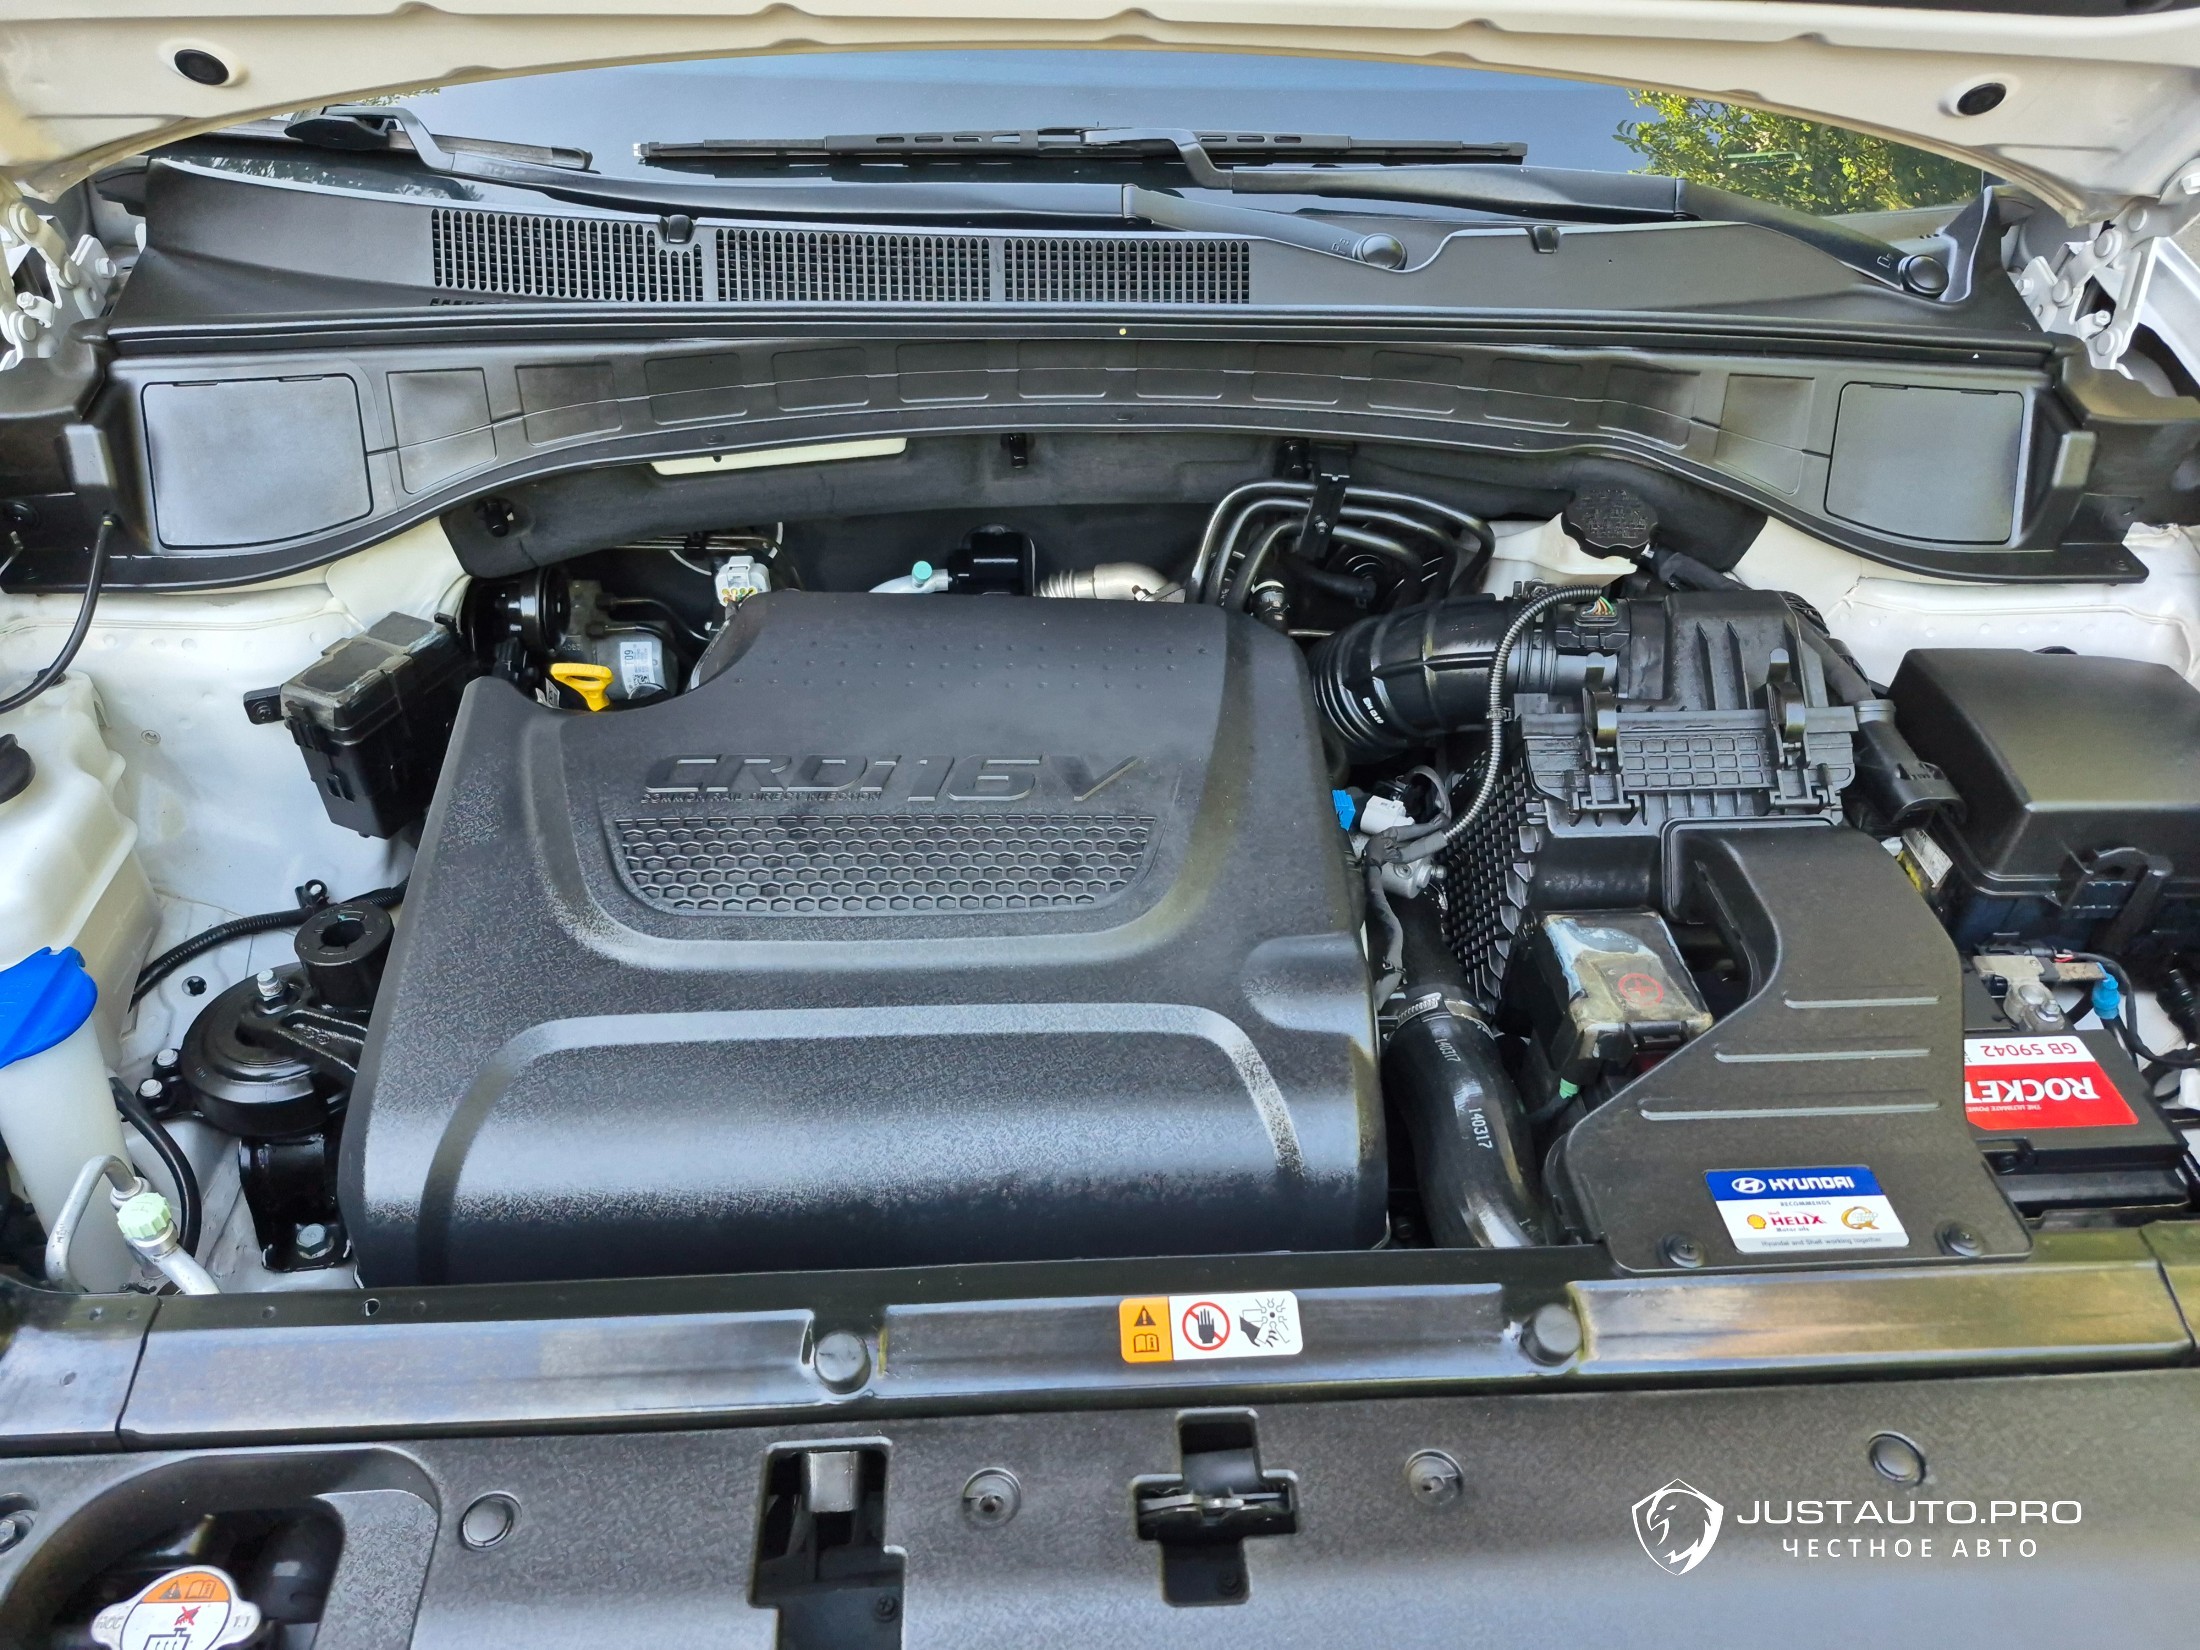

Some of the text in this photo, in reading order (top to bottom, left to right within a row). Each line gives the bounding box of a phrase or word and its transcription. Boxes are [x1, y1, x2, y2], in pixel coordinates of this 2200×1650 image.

[641, 792, 707, 804] COMMON
[710, 792, 743, 803] RAIL
[748, 792, 804, 802] DIRECT
[1434, 1037, 1462, 1063] 140317
[1980, 1043, 2045, 1057] 59042
[2047, 1042, 2077, 1055] GB
[1990, 1104, 2025, 1112] ULTIMATE
[2026, 1104, 2042, 1112] THE
[1468, 1107, 1493, 1150] 140317
[1768, 1175, 1856, 1192] HYUNDAI
[1780, 1199, 1832, 1207] RECOMMENDS
[1771, 1215, 1824, 1227] HELIX
